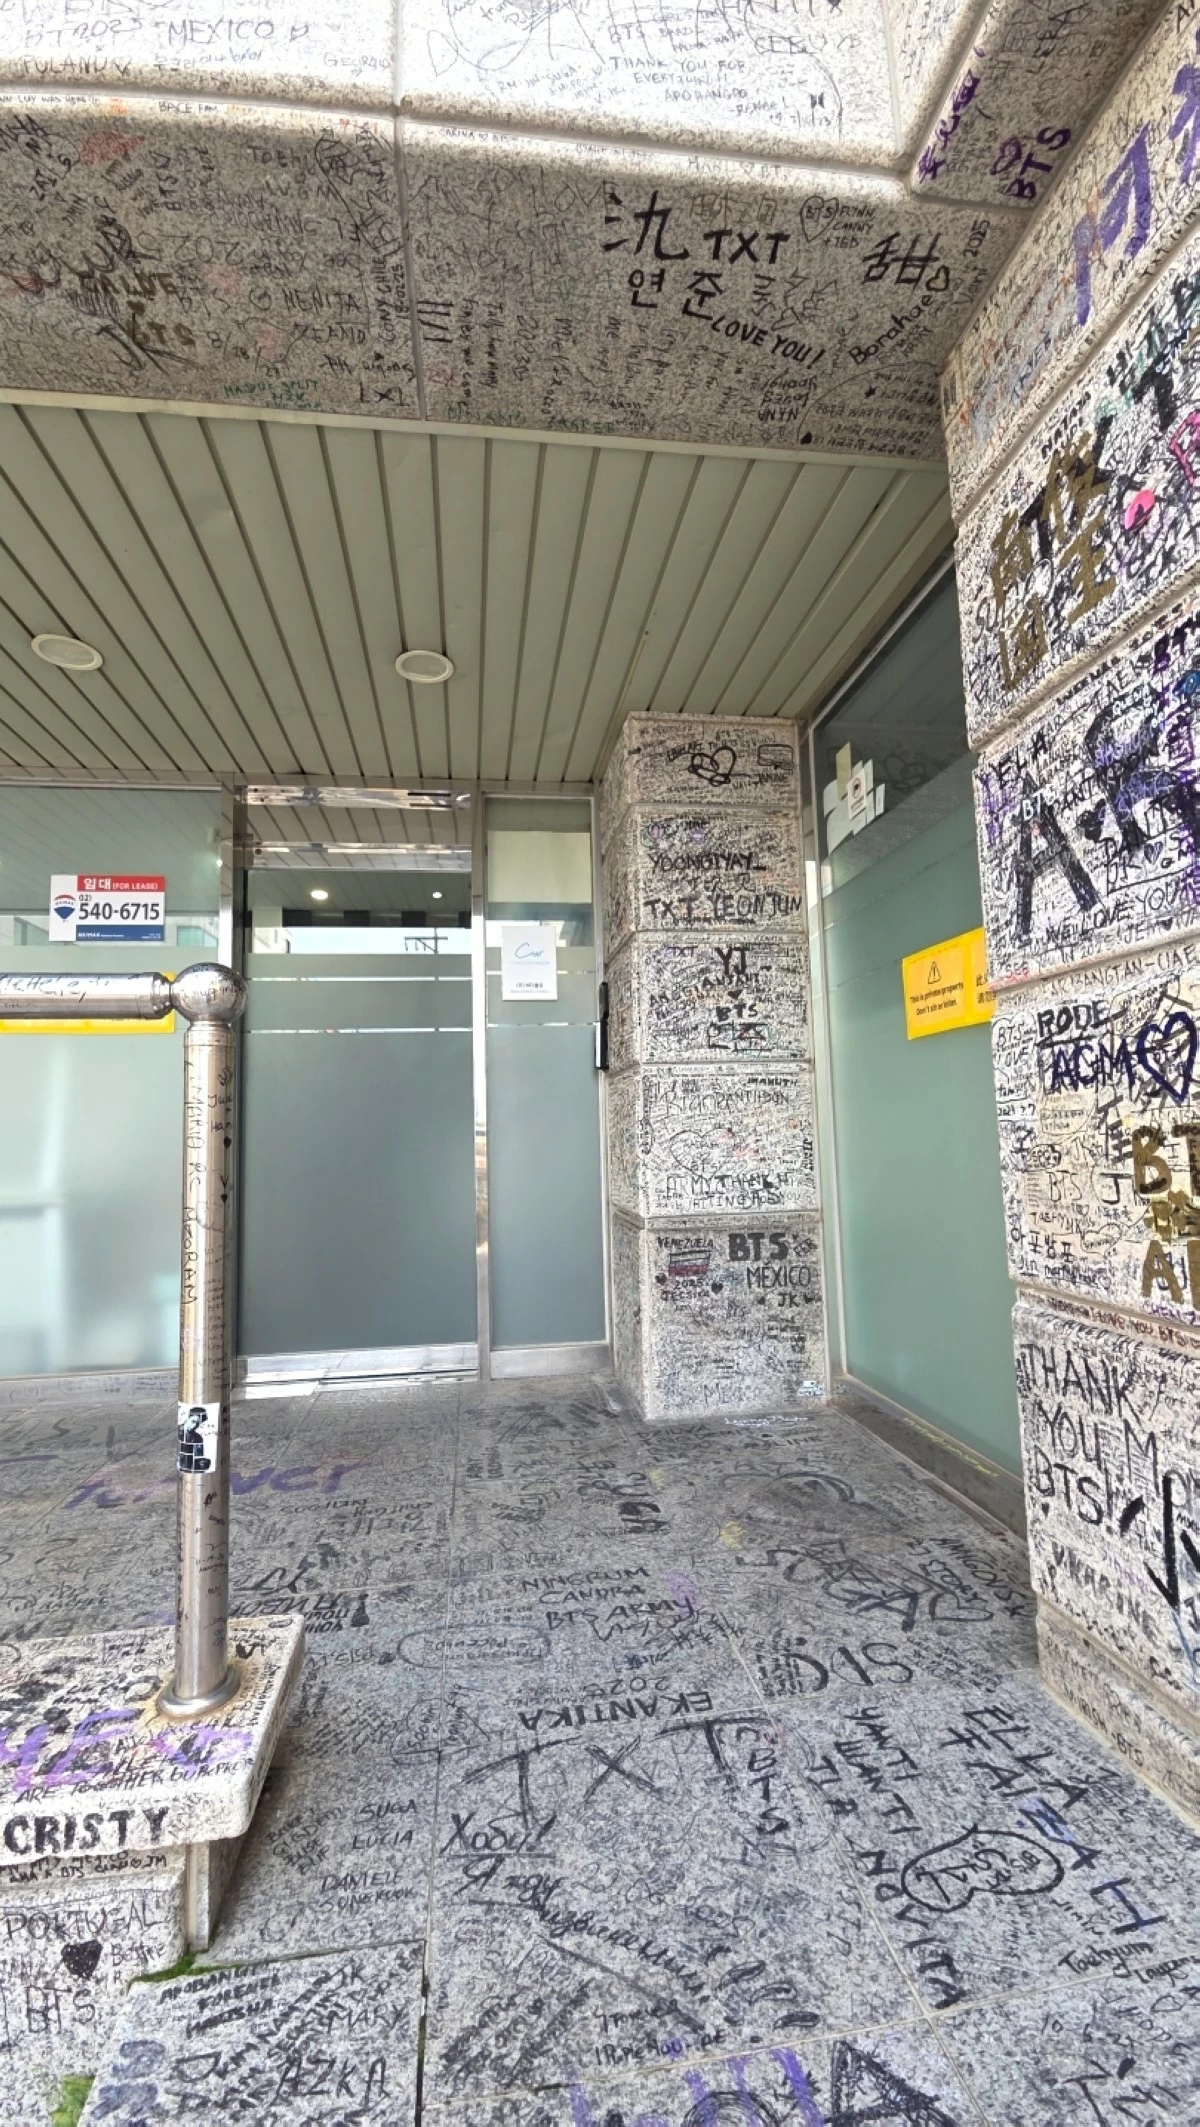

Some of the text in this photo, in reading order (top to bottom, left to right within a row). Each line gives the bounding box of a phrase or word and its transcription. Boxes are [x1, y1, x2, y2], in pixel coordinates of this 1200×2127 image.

[168, 20, 274, 46] MEXICO
[609, 56, 746, 74] THANK YOU FOR
[1003, 127, 1072, 200] BTS
[704, 229, 791, 265] TXT
[711, 314, 827, 371] LOVE YOU!
[83, 877, 111, 891] 임대
[131, 882, 159, 891] LEASE)
[78, 902, 160, 921] 540-6715
[643, 897, 701, 925] TXT
[1080, 901, 1132, 938] LOVE
[656, 1232, 790, 1262] VENEZUELA BTS
[745, 1260, 812, 1290] MÉXICO
[1019, 1342, 1144, 1430] THANK
[1036, 1399, 1104, 1474] YOU
[517, 1691, 714, 1730] EKANTIKA
[358, 1799, 418, 1822] SUGA
[3, 1805, 170, 1856] CRISTY
[351, 1829, 414, 1851] LUCIA
